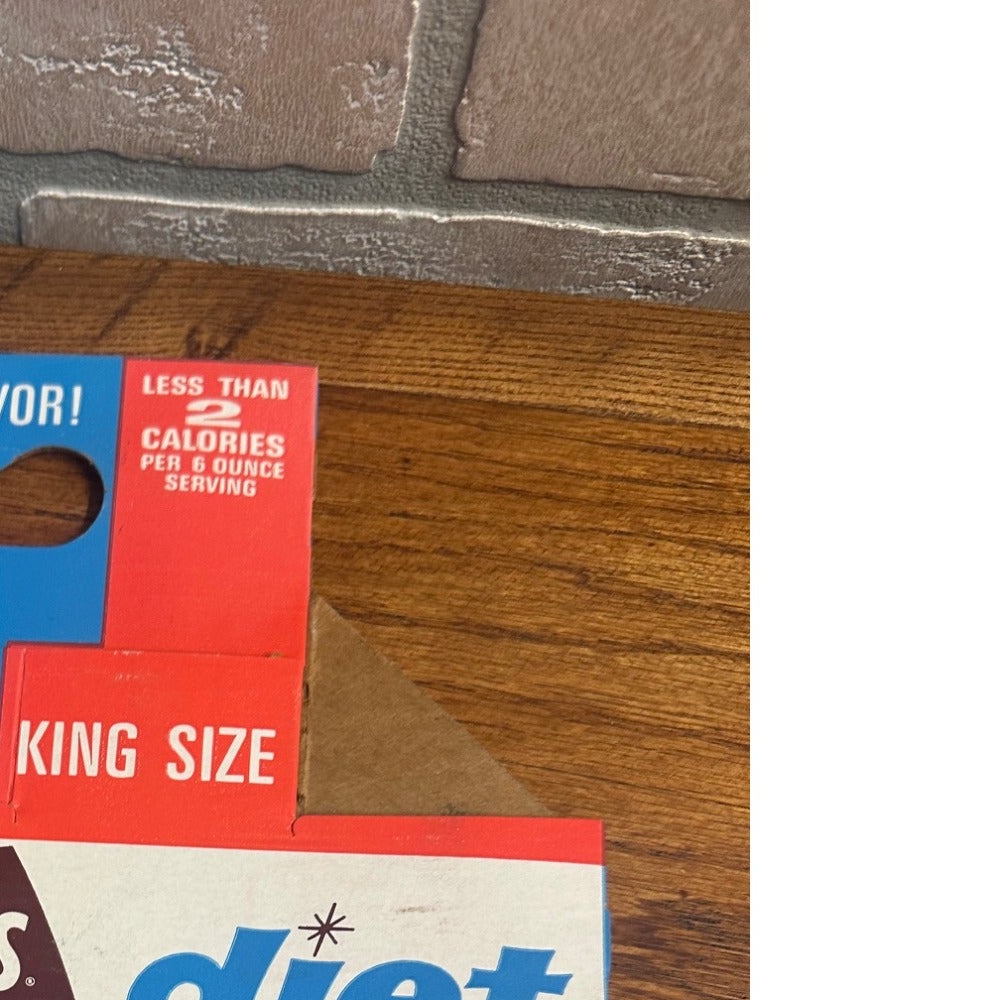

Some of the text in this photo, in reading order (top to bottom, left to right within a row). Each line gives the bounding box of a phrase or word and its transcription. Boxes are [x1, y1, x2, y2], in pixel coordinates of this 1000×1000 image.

[142, 374, 290, 400] LESS THAN
[185, 399, 242, 429] 2
[141, 427, 286, 458] CALORIES
[140, 454, 285, 479] PER 6 OUNCE
[164, 474, 257, 497] SERVING
[17, 720, 277, 785] KING SIZE
